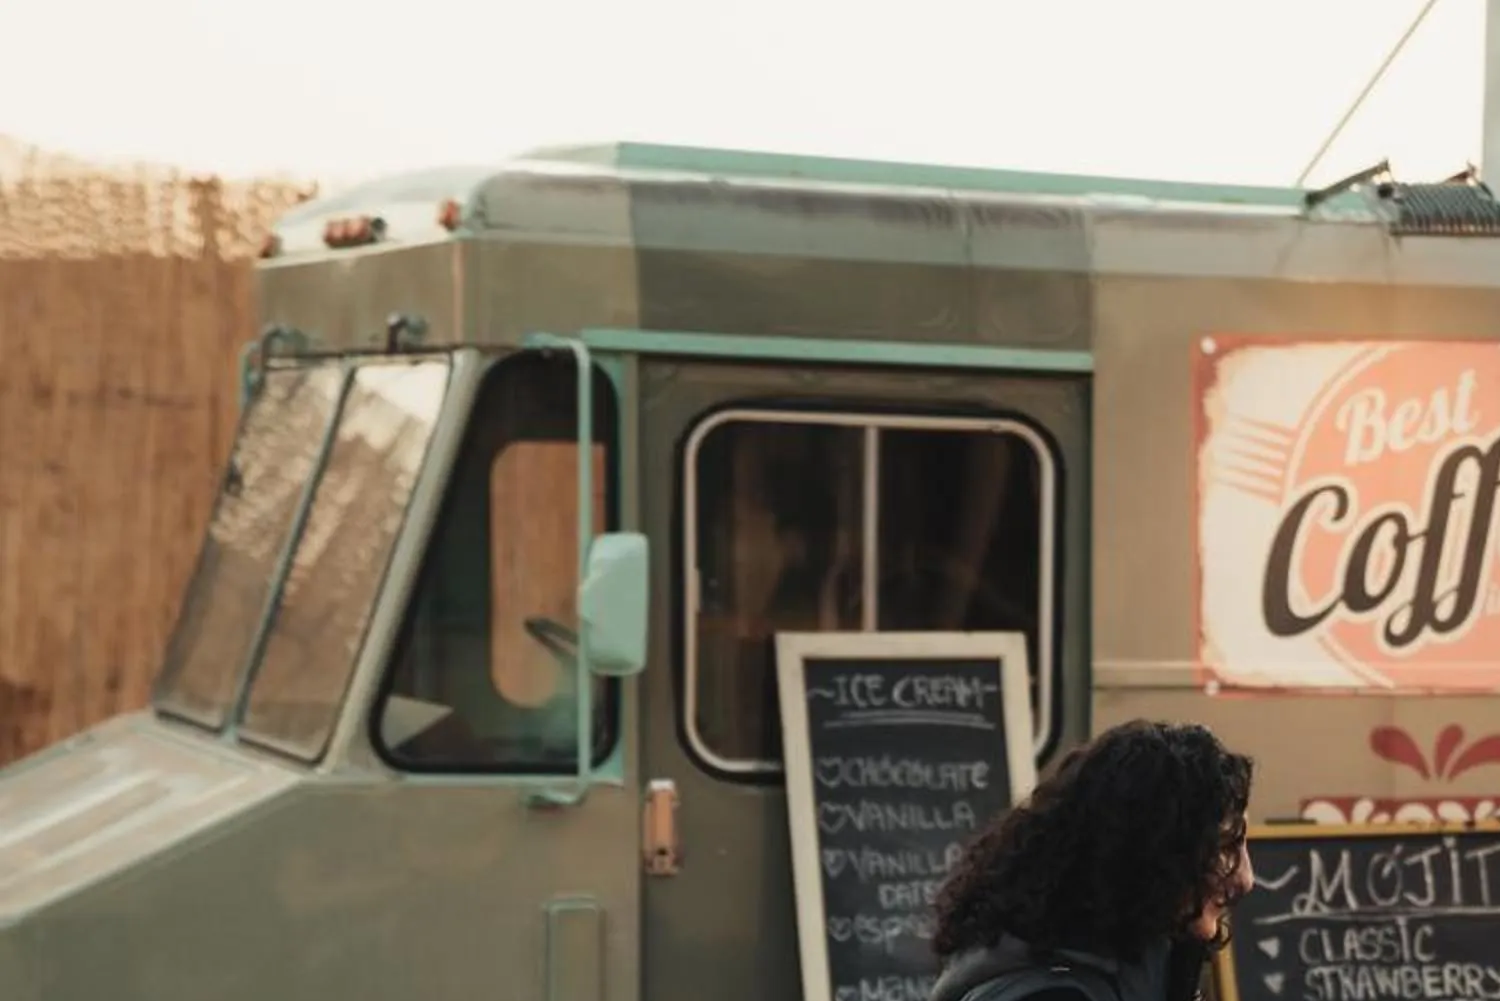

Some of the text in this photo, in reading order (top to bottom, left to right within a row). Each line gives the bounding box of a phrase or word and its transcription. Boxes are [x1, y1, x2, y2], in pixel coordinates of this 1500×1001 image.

[1338, 370, 1479, 465] Best
[832, 673, 985, 708] ICE CREAM
[845, 797, 976, 833] VANILLA
[1299, 917, 1436, 964] CLASSIC
